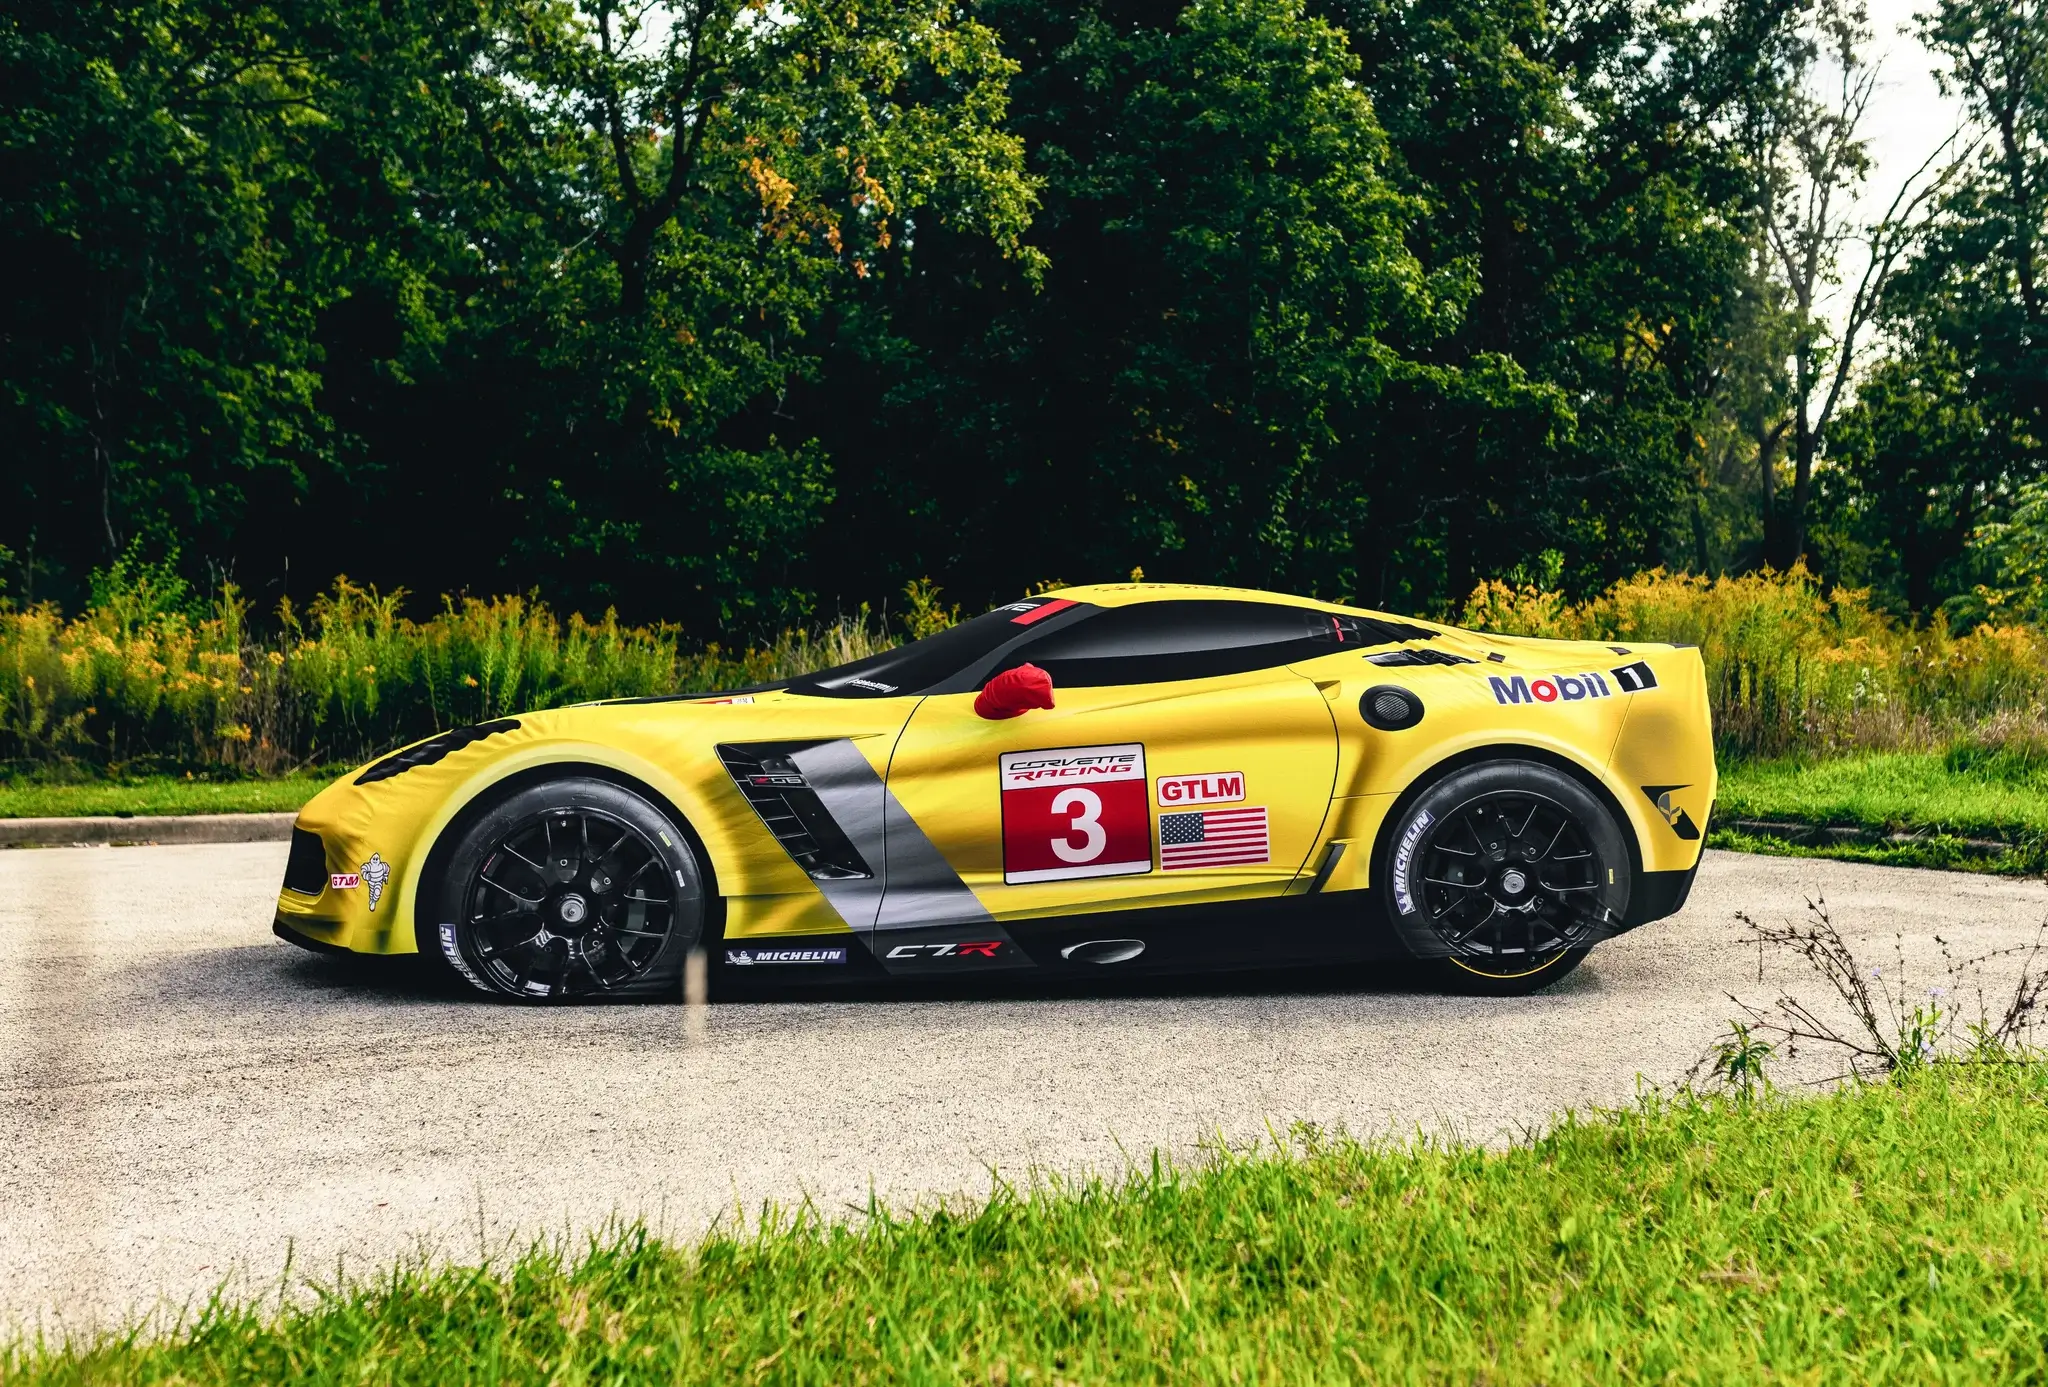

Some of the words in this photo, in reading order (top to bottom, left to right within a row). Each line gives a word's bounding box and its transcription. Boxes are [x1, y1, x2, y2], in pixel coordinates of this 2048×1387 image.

[1488, 672, 1610, 704] Mobil
[1622, 667, 1644, 689] 1
[1008, 764, 1132, 781] RACING
[1010, 754, 1136, 770] CORVETTE
[1162, 777, 1241, 801] GTLM
[1050, 787, 1107, 863] 3
[1395, 812, 1430, 893] MICHELIN
[755, 950, 841, 961] MICHELIN
